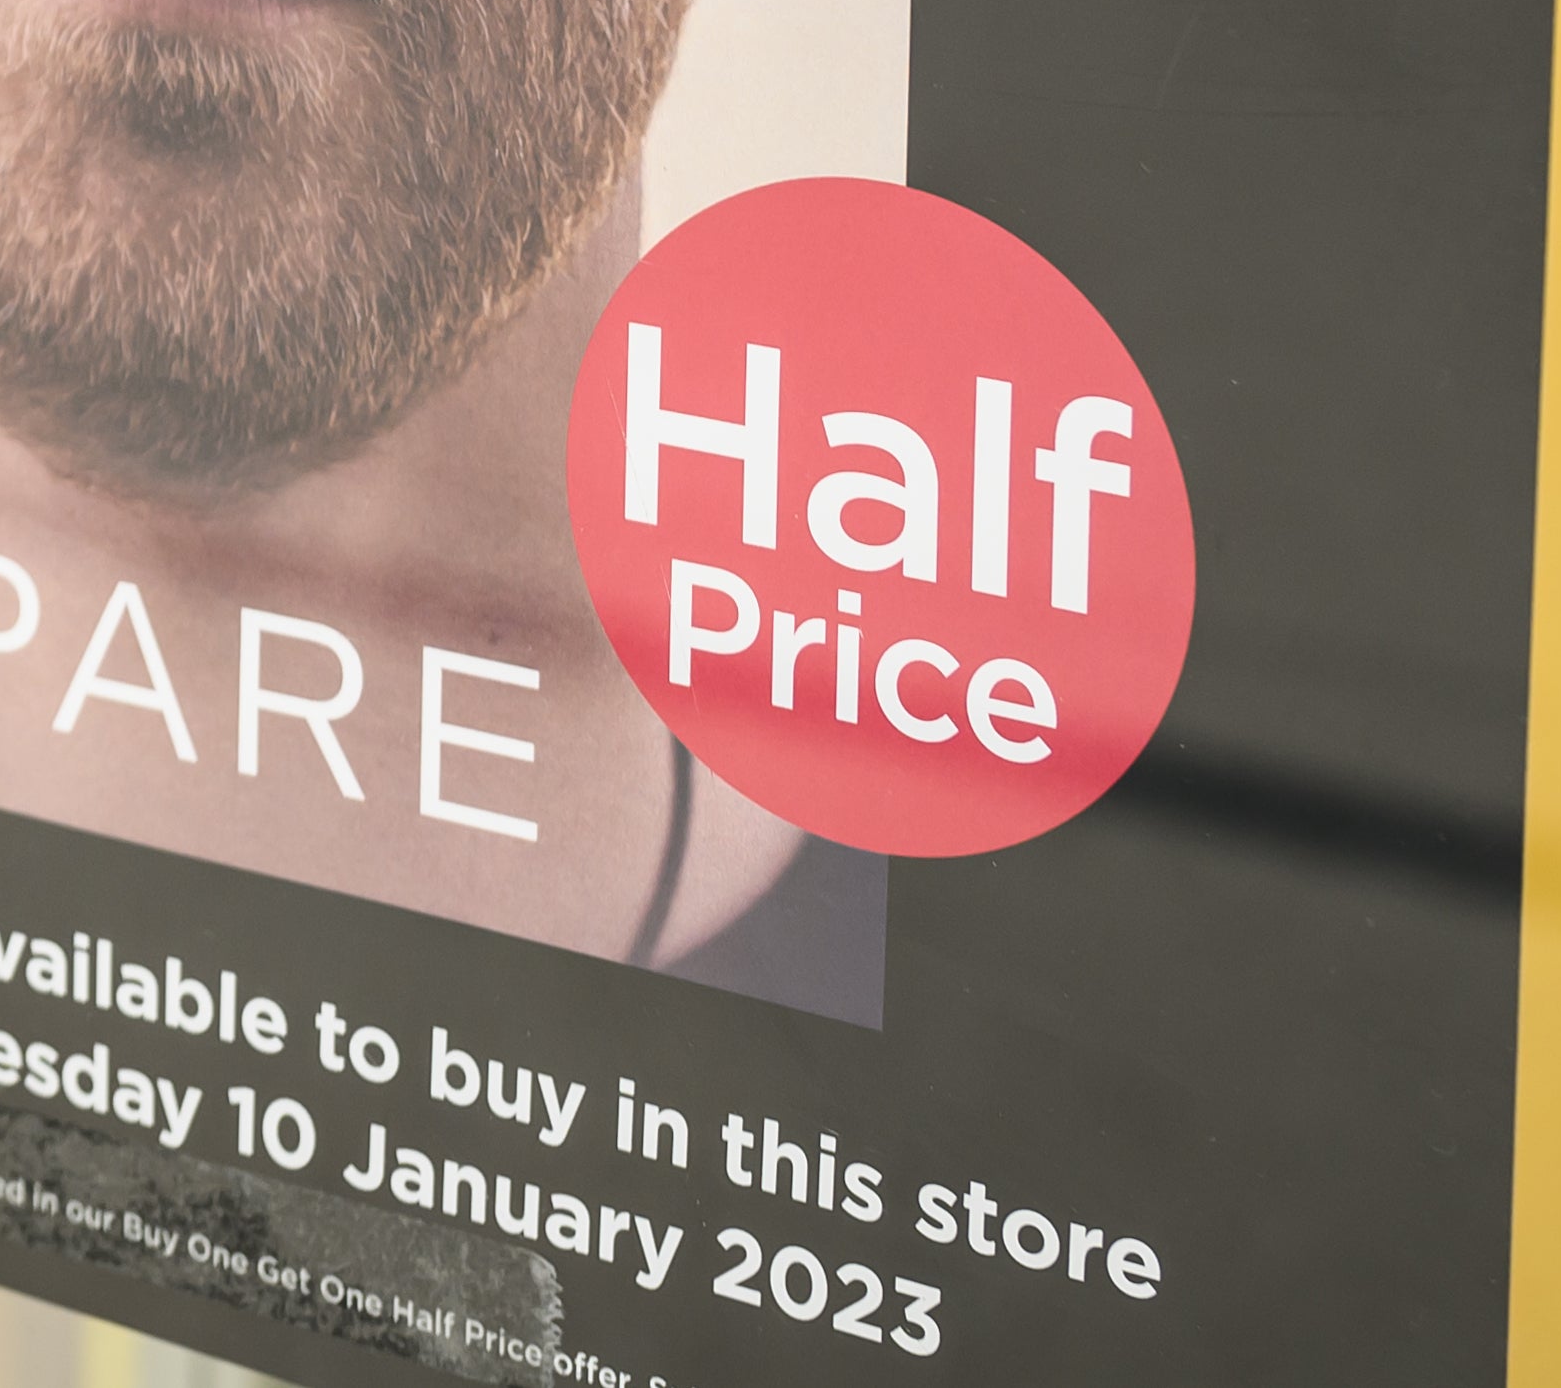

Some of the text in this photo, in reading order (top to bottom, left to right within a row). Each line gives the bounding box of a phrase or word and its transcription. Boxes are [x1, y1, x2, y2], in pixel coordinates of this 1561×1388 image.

[624, 321, 1134, 615] Half
[669, 557, 1059, 765] Price
[32, 1180, 60, 1215] in
[66, 1199, 115, 1231] our
[123, 1211, 180, 1259] Buy
[187, 1232, 250, 1275] One
[257, 1254, 312, 1296] Get
[320, 1274, 384, 1316] One
[392, 1295, 456, 1339] Half
[464, 1317, 543, 1369] Price
[228, 1086, 317, 1170] 10
[343, 1123, 683, 1290] January
[713, 1228, 943, 1357] 2023
[316, 1001, 400, 1083] to
[430, 1027, 586, 1146] buy
[616, 1077, 689, 1169] in
[721, 1113, 884, 1222] this
[915, 1181, 1162, 1299] store
